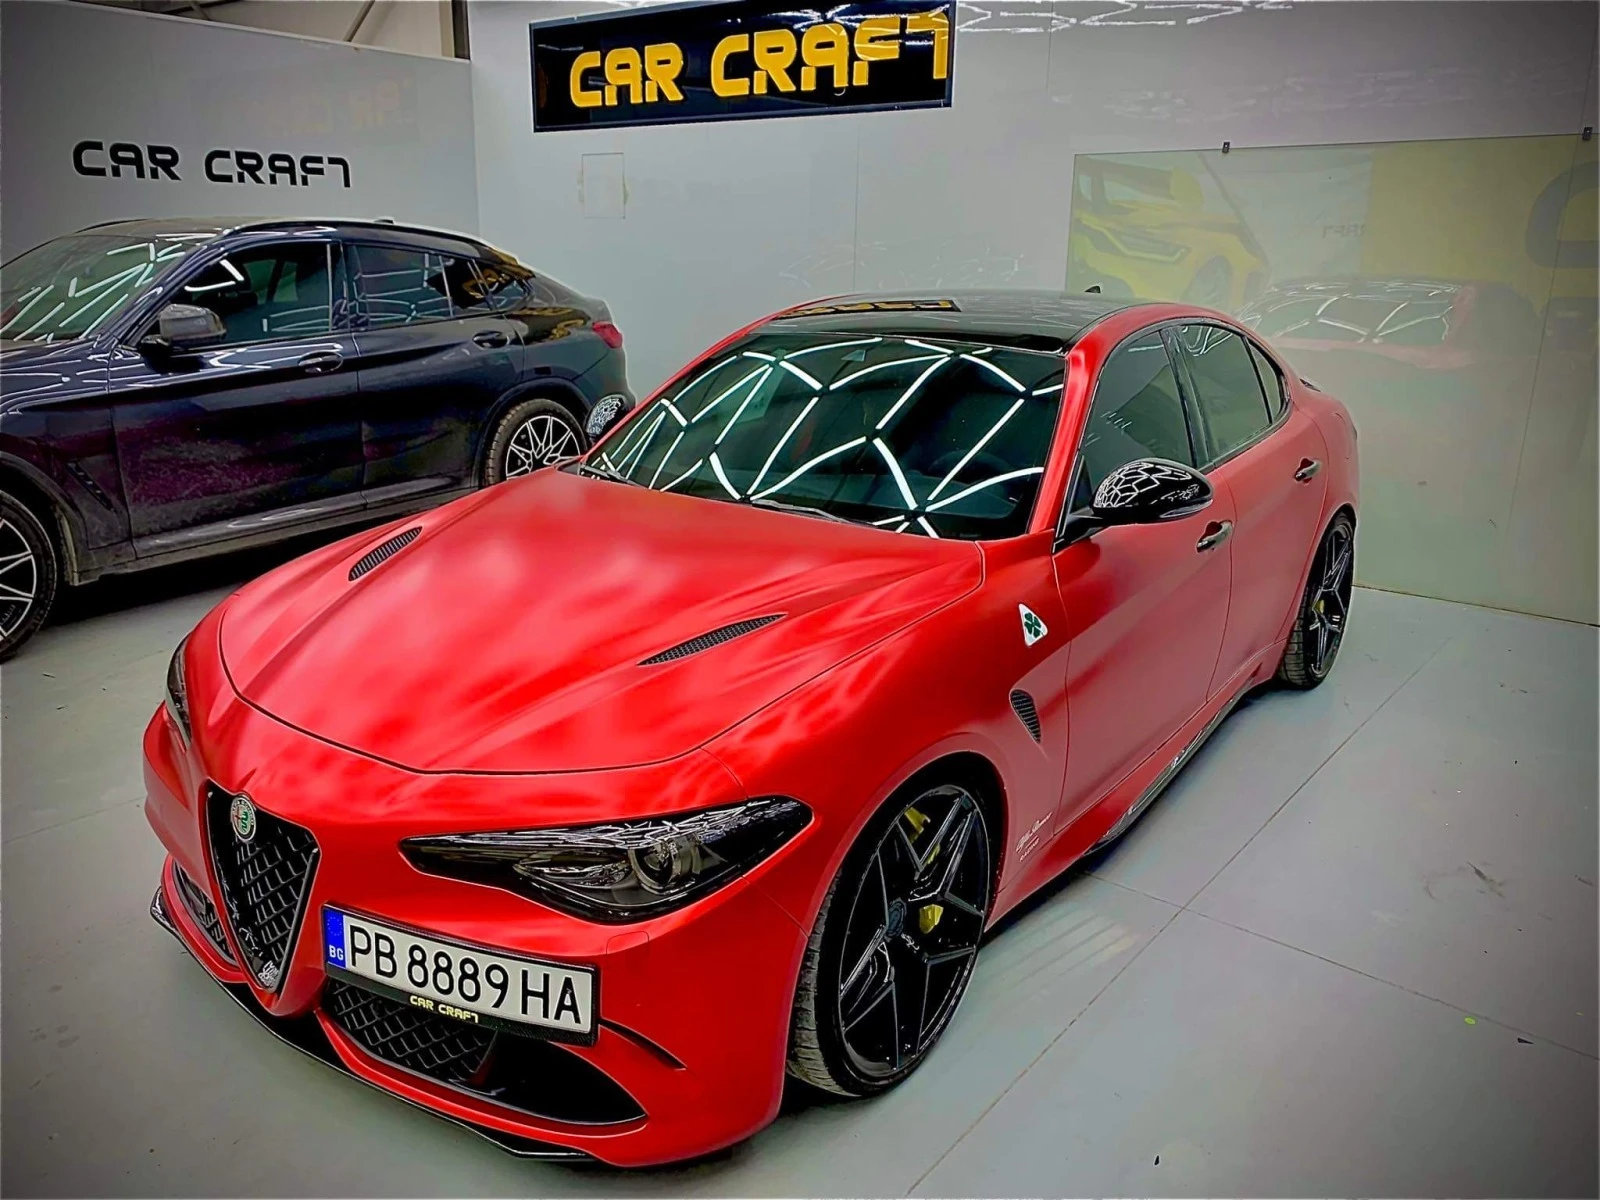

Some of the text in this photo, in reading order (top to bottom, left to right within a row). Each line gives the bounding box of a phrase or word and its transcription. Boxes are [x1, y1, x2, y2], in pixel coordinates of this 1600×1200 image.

[569, 11, 950, 108] CAR CRAFT
[72, 139, 351, 188] CAR CRAFT
[328, 944, 345, 961] BG
[349, 924, 398, 979] PB
[407, 943, 510, 1009] 8889
[521, 968, 582, 1025] HA
[409, 995, 479, 1024] CAR CRAFT
